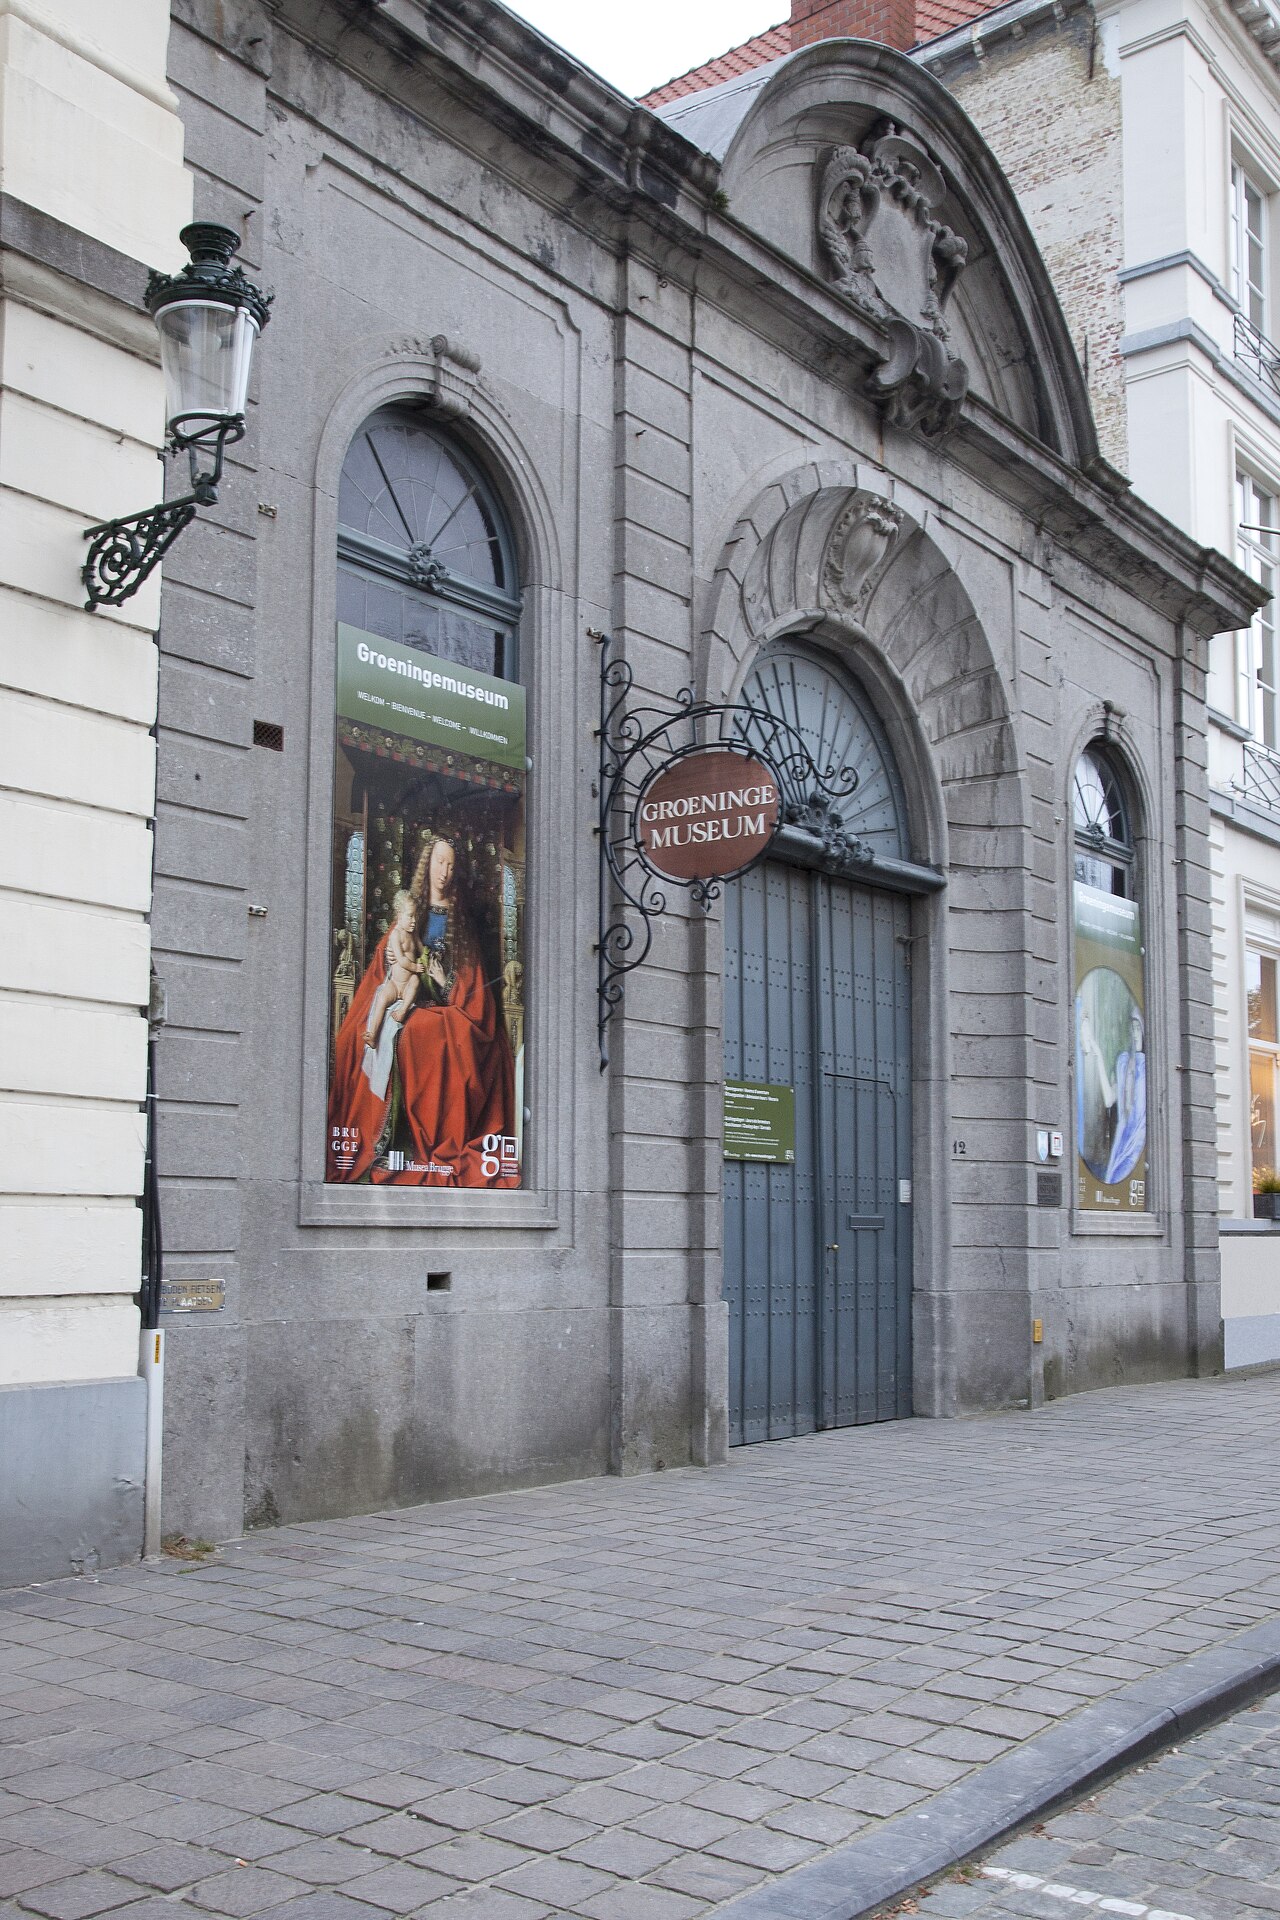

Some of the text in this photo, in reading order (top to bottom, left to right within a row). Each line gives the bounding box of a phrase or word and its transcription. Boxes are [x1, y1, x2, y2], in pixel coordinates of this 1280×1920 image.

[356, 642, 509, 710] Groeningemuseum
[356, 690, 385, 706] WELKOM
[391, 701, 426, 720] BIENVENUE
[431, 715, 462, 731] WELCOME
[469, 726, 508, 745] WILLKOMMEN
[641, 784, 776, 822] GROENINGE
[650, 812, 767, 850] MUSEUM
[332, 1126, 359, 1138] BRU
[331, 1140, 359, 1152] GGE
[952, 1140, 966, 1154] 12
[405, 1161, 454, 1176] Musea Brugge
[161, 1284, 221, 1295] BODEN FIETSEN
